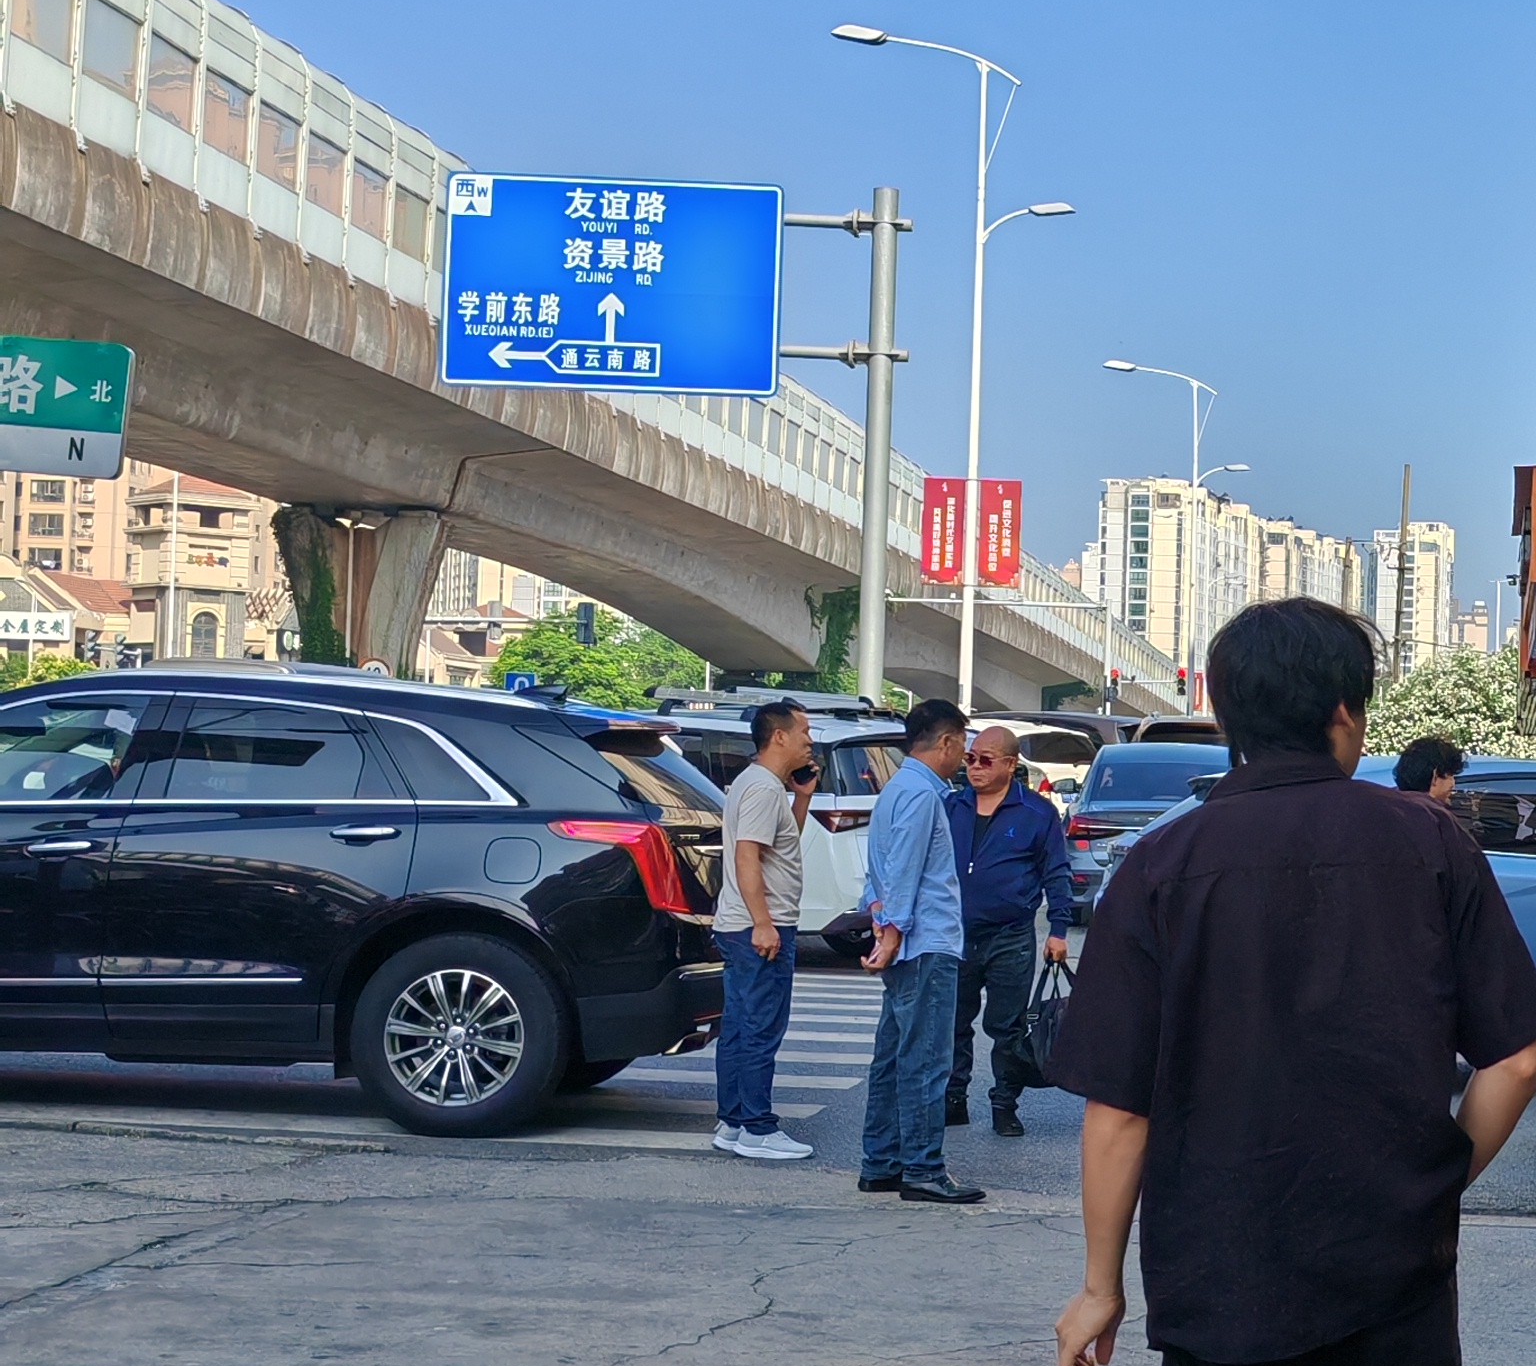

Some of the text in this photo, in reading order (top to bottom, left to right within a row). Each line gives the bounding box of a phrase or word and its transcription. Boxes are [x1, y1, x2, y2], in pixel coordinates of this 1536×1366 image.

[455, 179, 488, 197] 西 W
[564, 188, 667, 223] 友谊路
[581, 221, 617, 234] YOUYI
[563, 237, 665, 273] 资景路
[575, 271, 613, 284] ZIJING
[457, 291, 560, 325] 学前东路
[561, 348, 651, 371] 通云南路
[0, 355, 112, 414] 路 北
[68, 437, 85, 461] N
